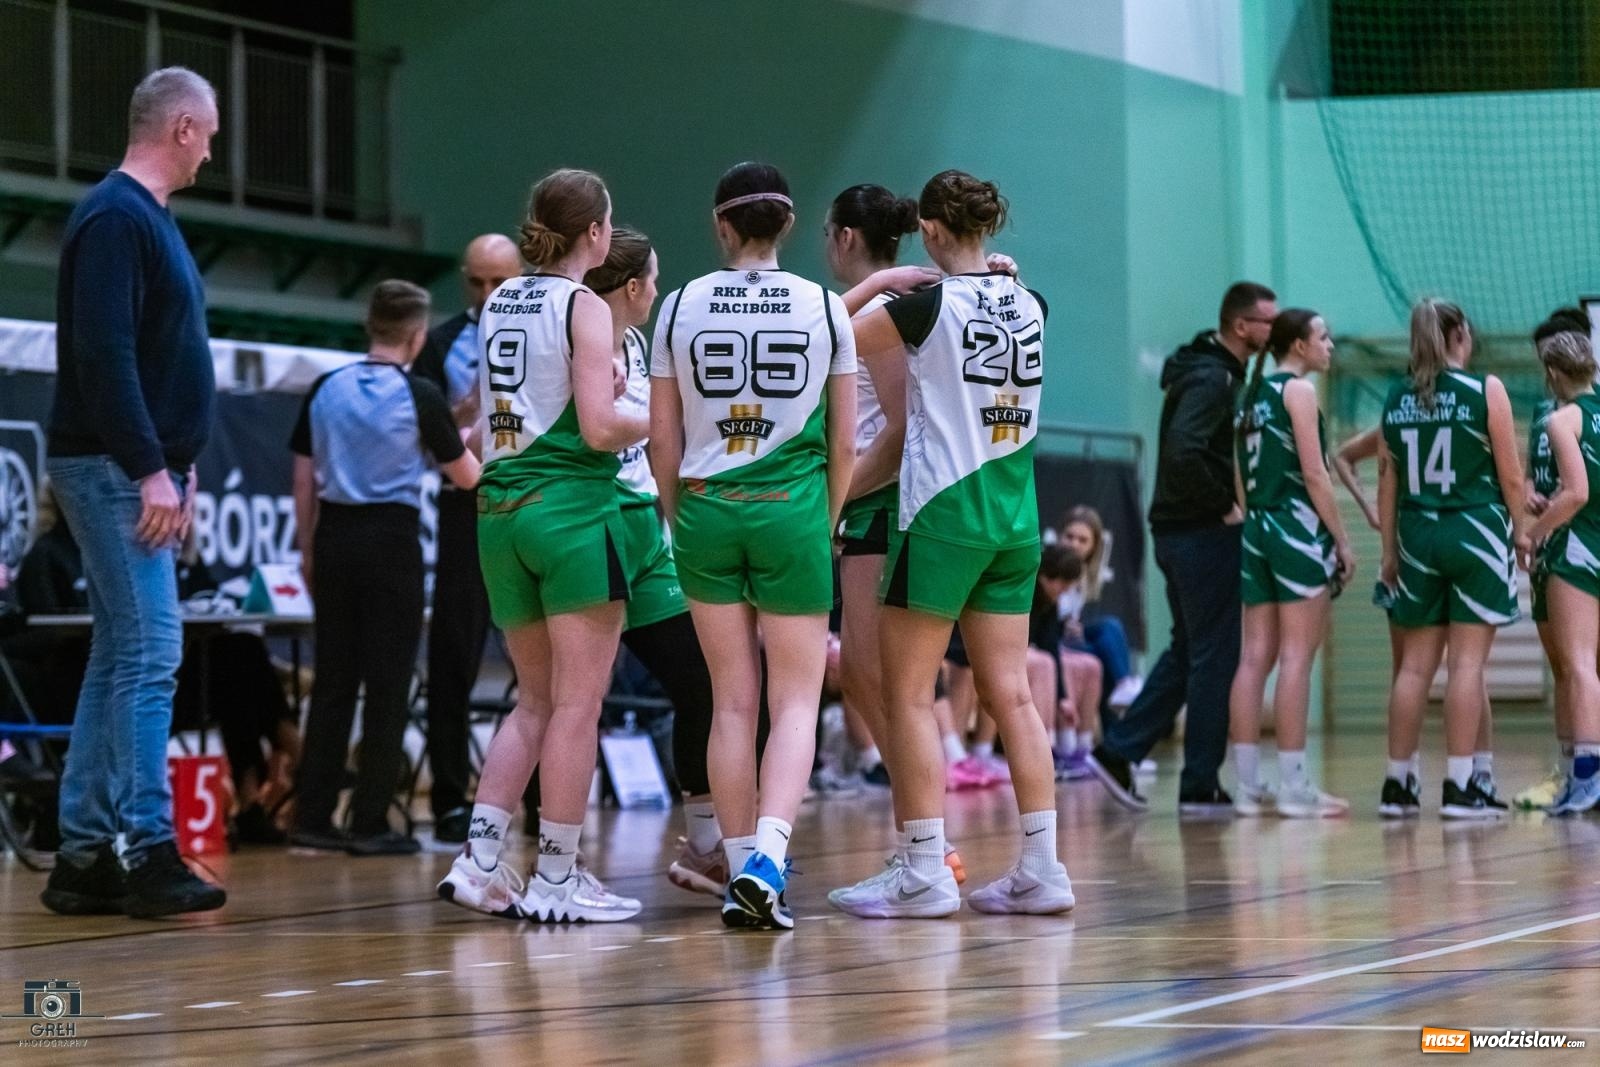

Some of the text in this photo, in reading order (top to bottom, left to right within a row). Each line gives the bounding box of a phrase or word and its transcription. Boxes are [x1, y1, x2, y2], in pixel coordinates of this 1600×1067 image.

[497, 288, 548, 300] RKK AZS
[713, 287, 790, 298] RKK AZS
[488, 302, 543, 314] RACIBÓRZ
[709, 300, 791, 314] RACIBÓRZ
[486, 328, 527, 393] 9
[962, 319, 1043, 387] 26
[690, 330, 810, 398] 85
[983, 408, 1029, 425] SEGET
[721, 420, 771, 436] SEGET
[1400, 426, 1456, 496] 14
[187, 765, 218, 832] 5
